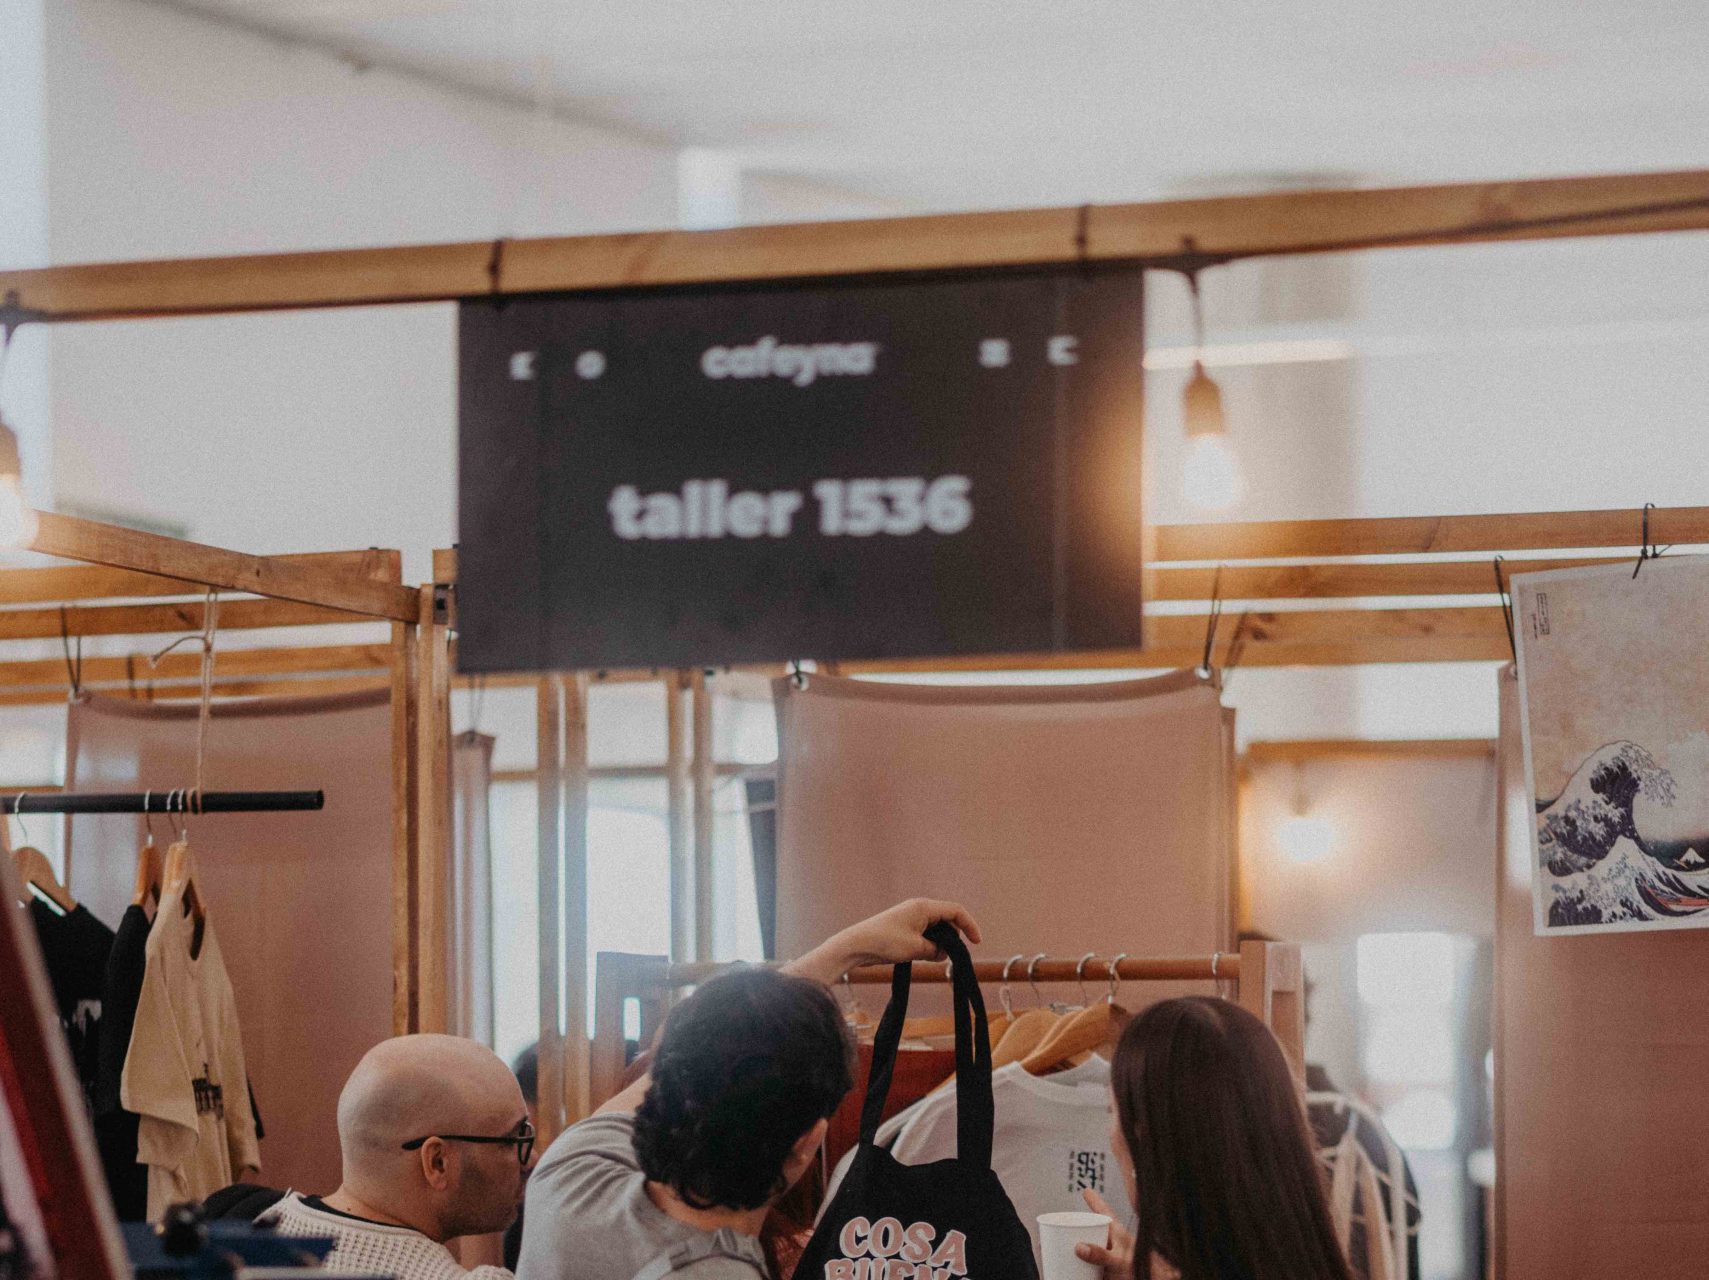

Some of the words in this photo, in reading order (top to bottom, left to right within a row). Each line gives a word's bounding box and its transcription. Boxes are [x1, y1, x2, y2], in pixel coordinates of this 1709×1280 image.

[608, 478, 802, 539] taller
[813, 474, 973, 536] 1536
[839, 1216, 967, 1276] COSA
